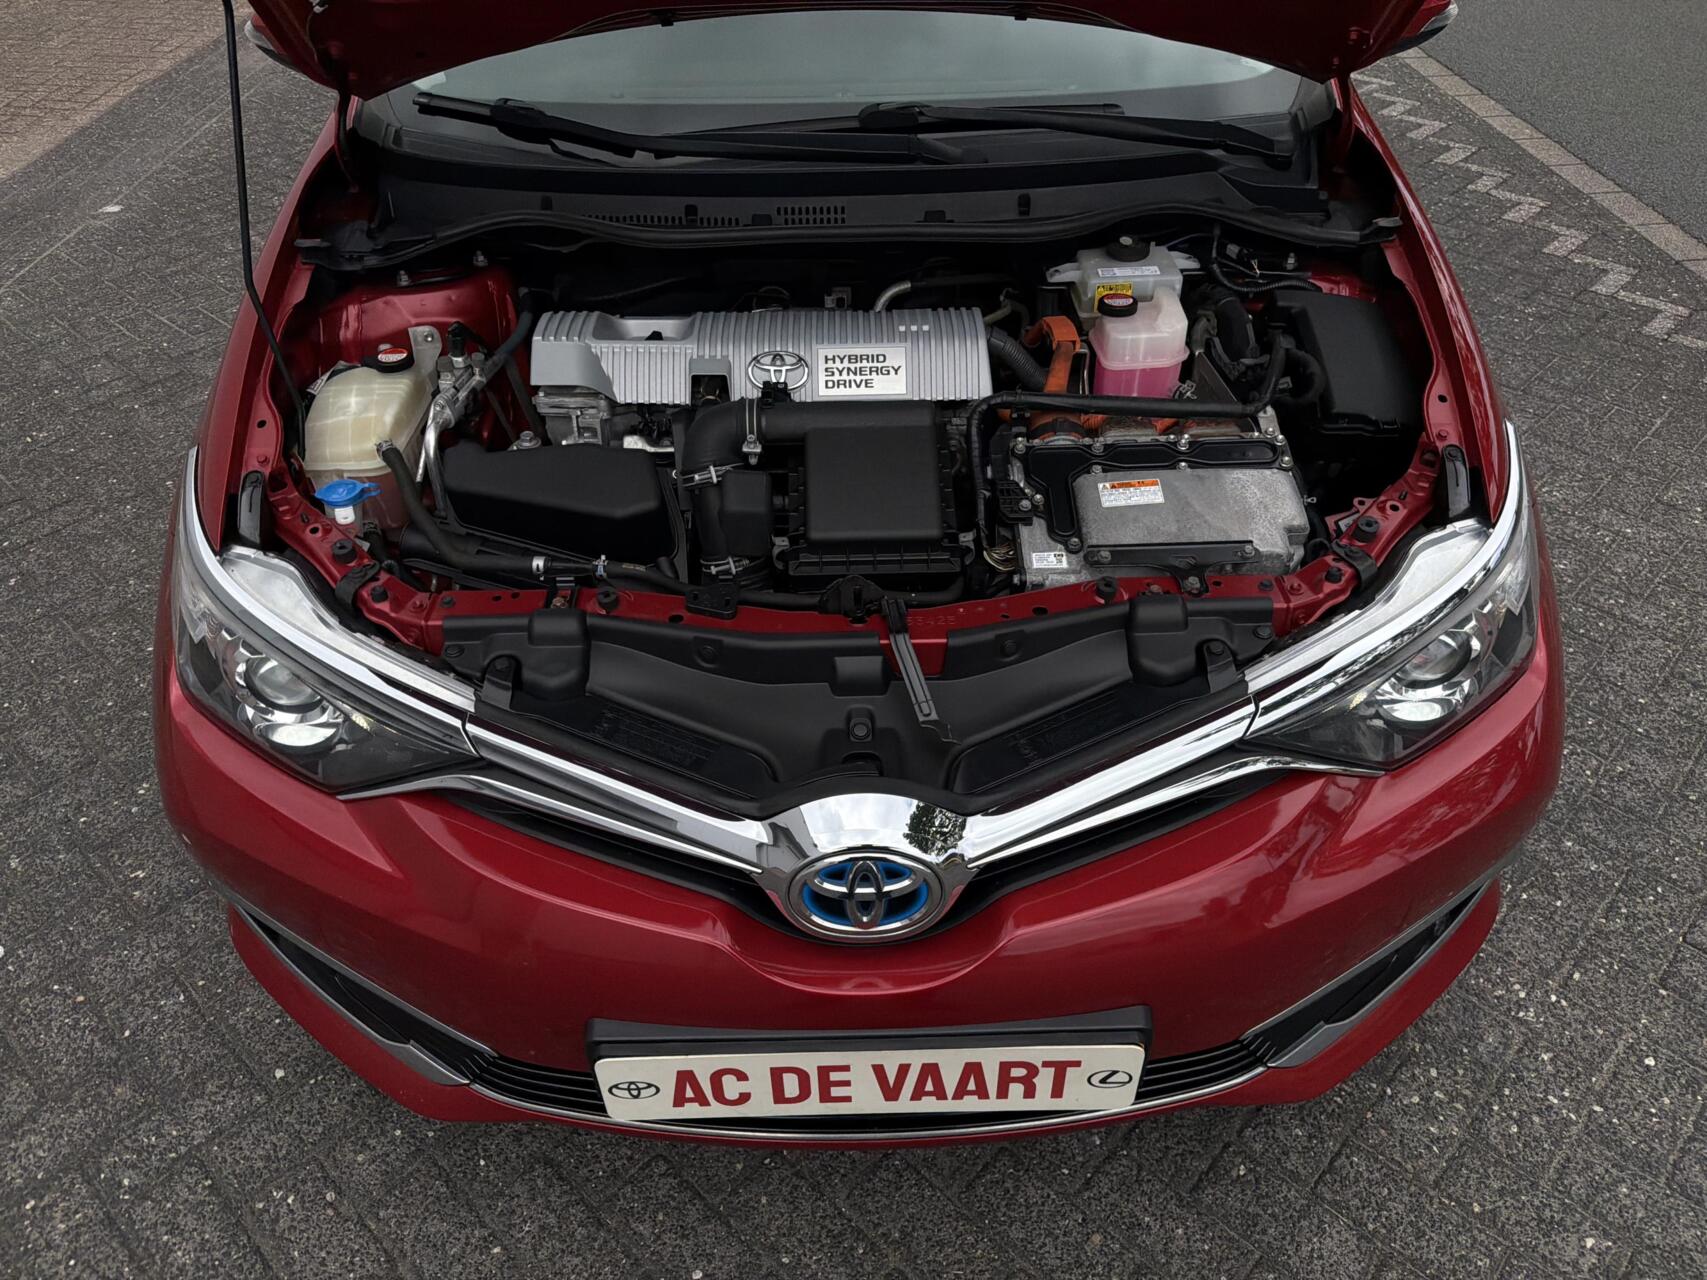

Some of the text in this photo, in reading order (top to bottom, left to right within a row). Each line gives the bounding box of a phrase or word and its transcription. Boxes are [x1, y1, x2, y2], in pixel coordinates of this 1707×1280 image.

[824, 353, 887, 365] HYBRID
[824, 365, 902, 377] SYNERGY
[824, 378, 875, 389] DRIVE
[672, 1060, 1083, 1108] AC DE VAART
